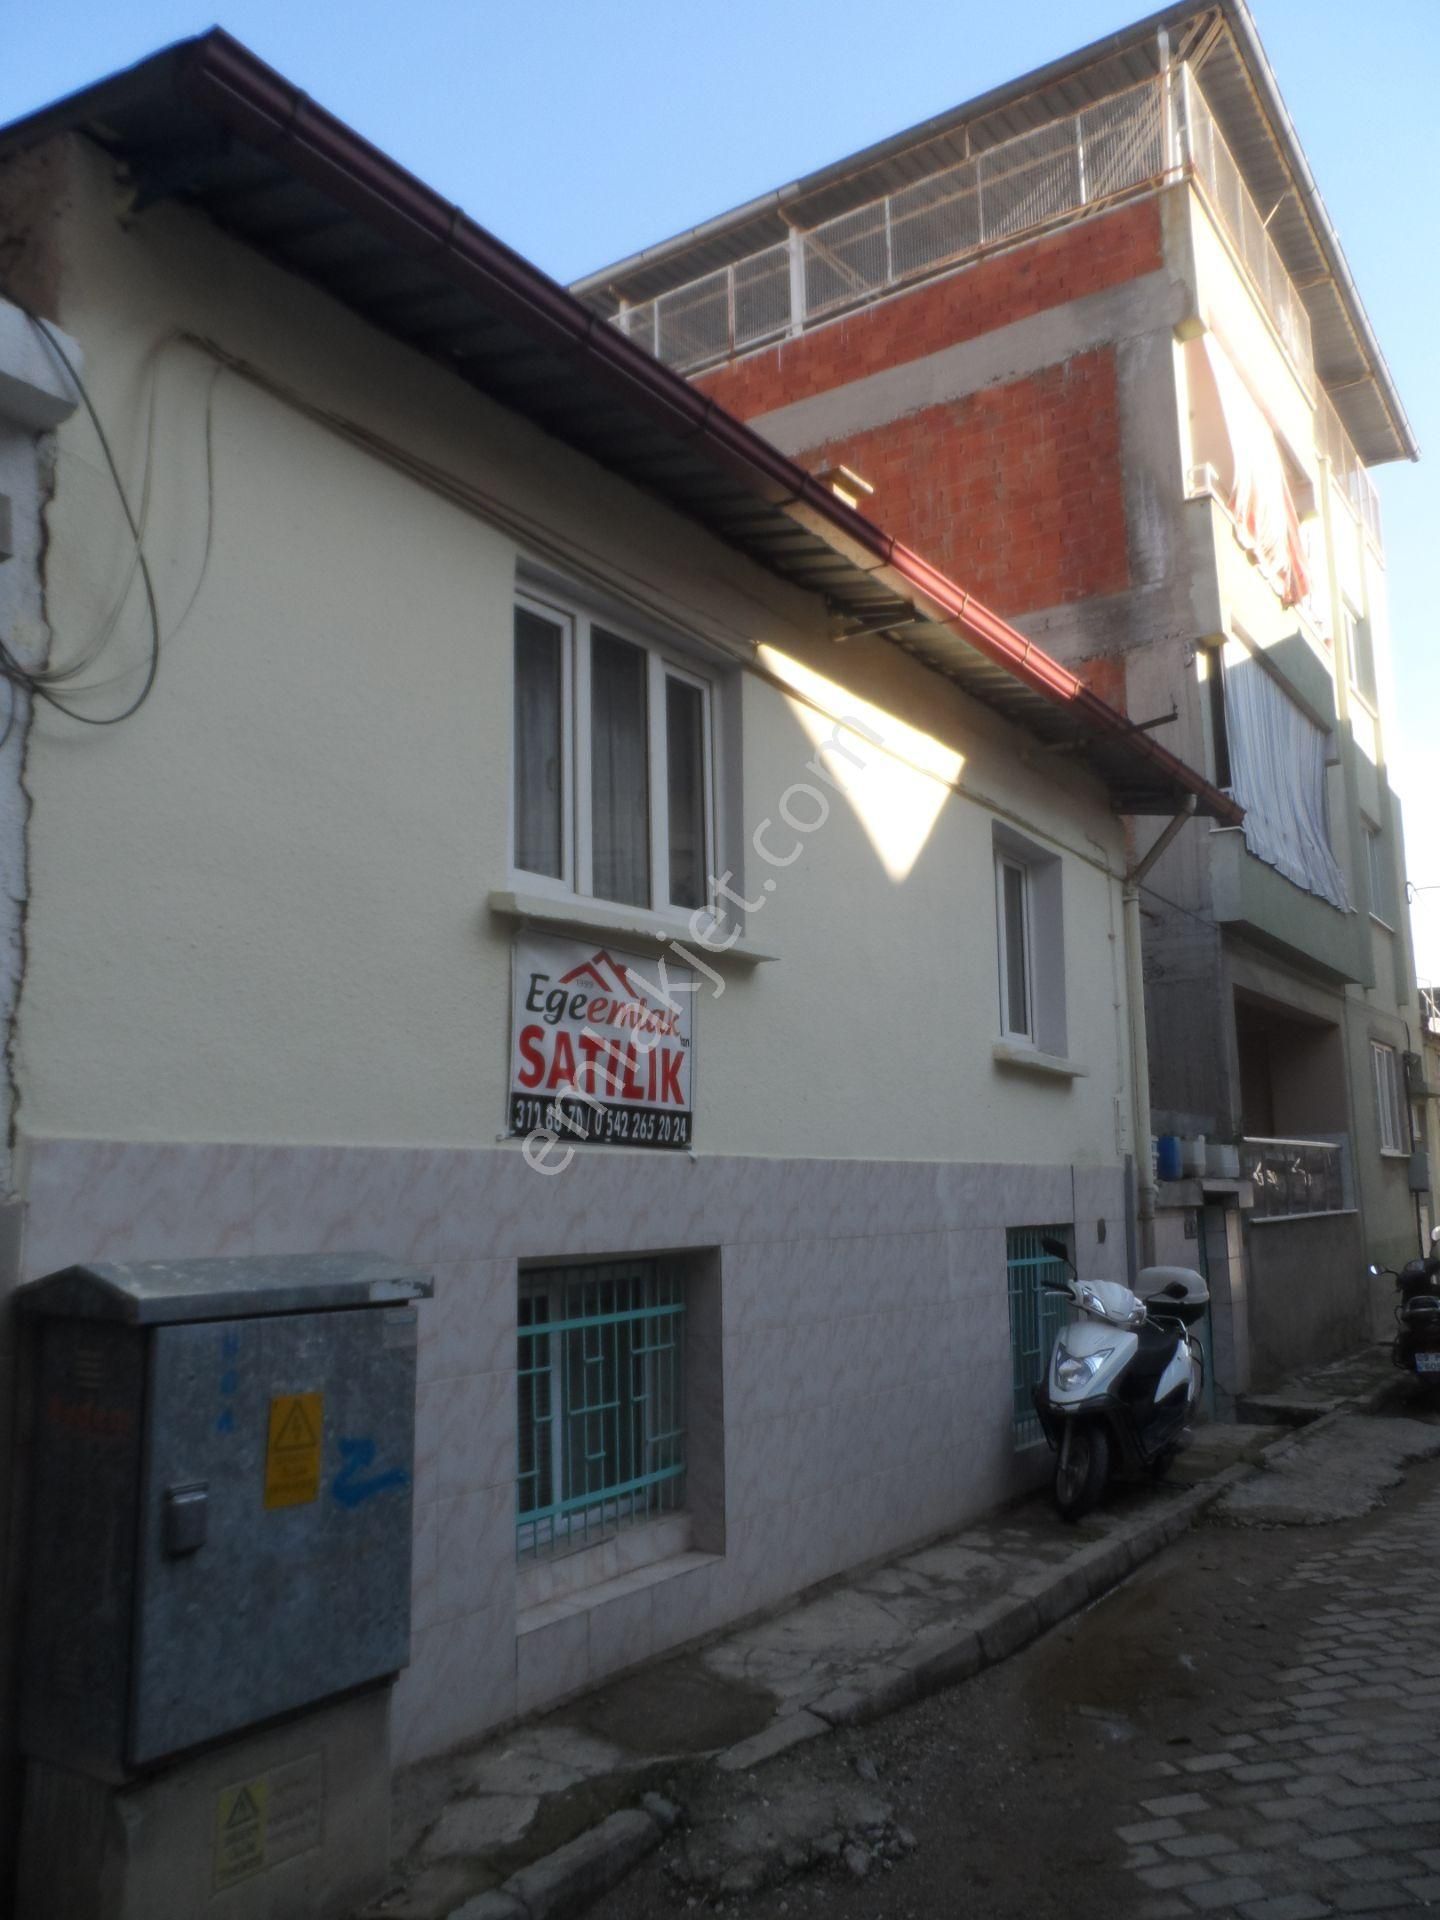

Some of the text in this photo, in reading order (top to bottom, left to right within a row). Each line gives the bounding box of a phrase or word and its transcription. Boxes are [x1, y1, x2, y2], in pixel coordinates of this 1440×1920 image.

[518, 1024, 685, 1105] SATILIK
[516, 1100, 541, 1128] 312
[606, 1110, 628, 1137] 542
[632, 1112, 655, 1140] 265
[657, 1115, 671, 1141] 20
[673, 1116, 686, 1142] 24
